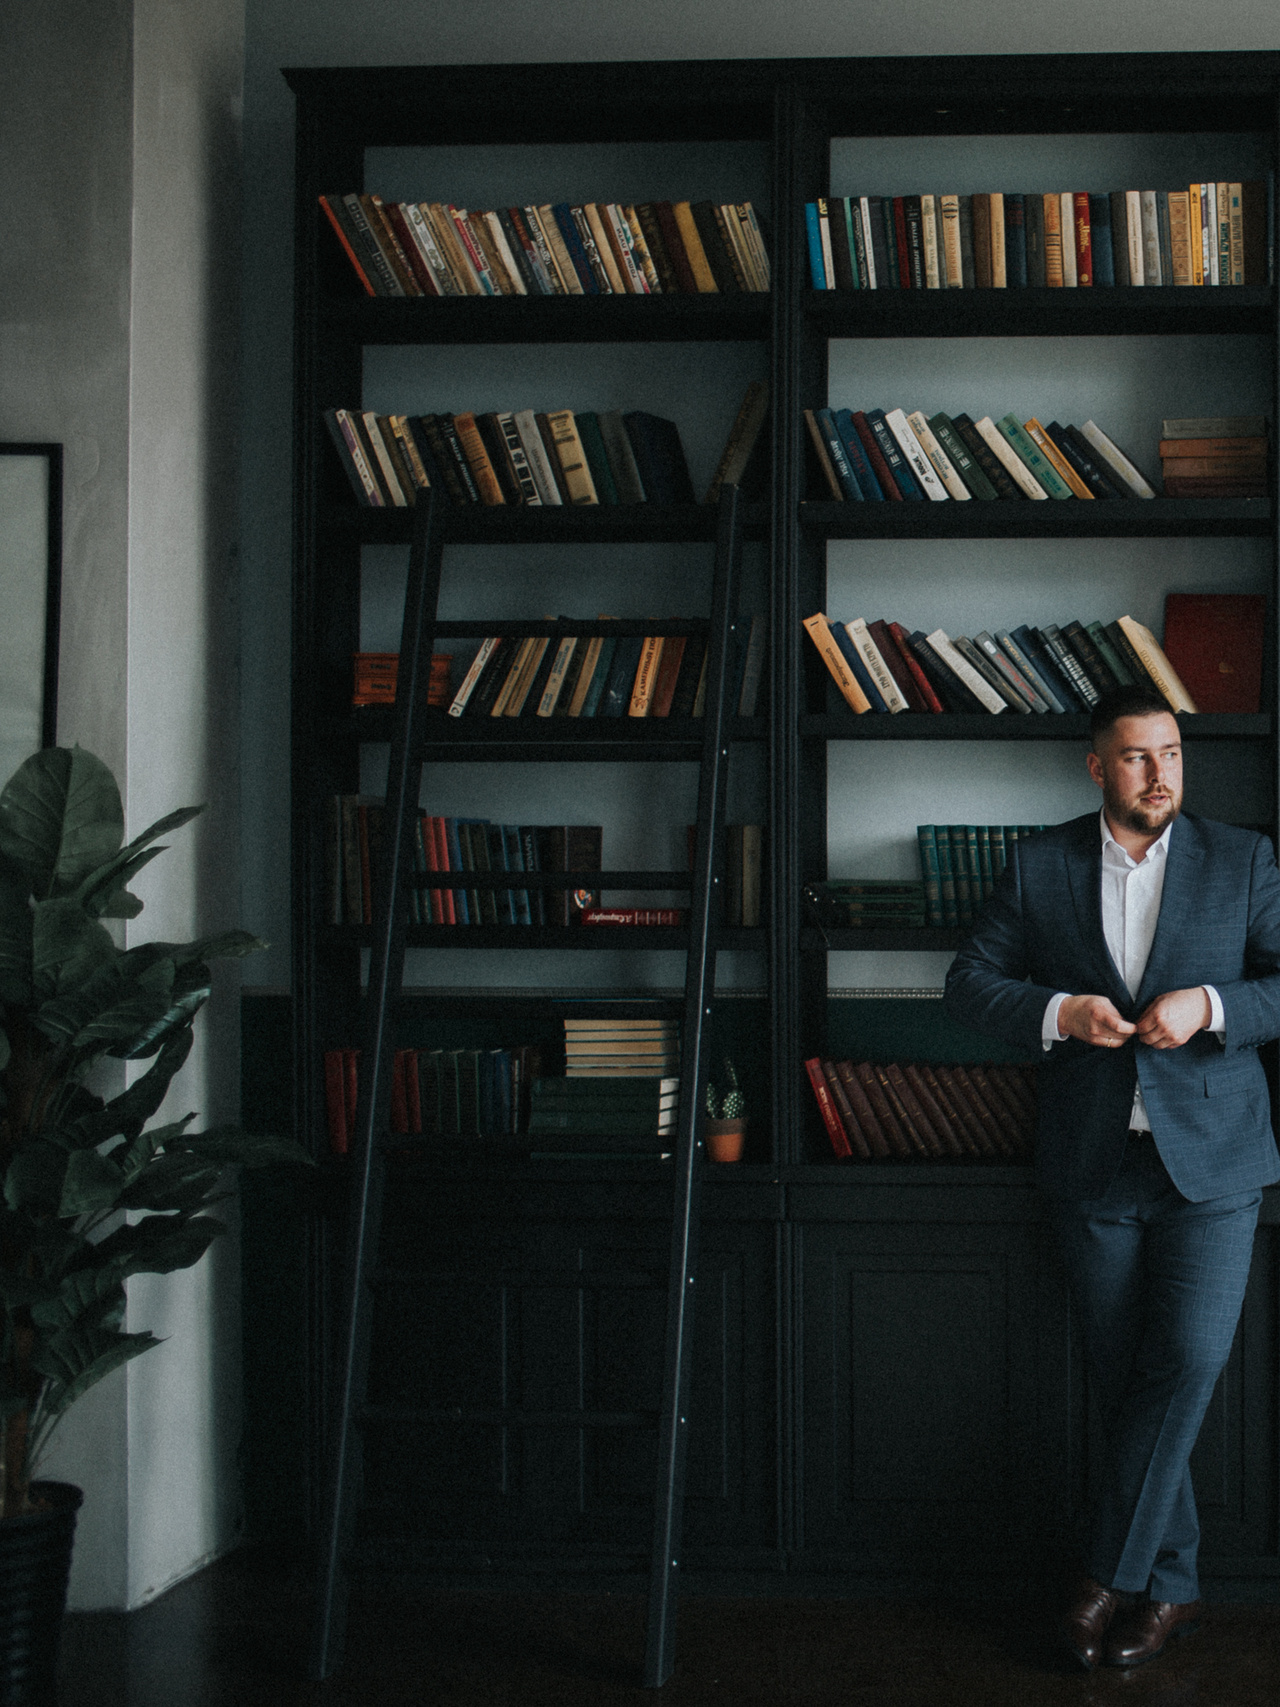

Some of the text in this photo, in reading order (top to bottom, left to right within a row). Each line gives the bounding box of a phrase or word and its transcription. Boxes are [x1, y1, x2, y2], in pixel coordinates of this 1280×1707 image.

[615, 227, 627, 249] ПУТИ
[625, 256, 636, 279] ГОДЫ
[636, 650, 655, 696] КАМЕННЫЙ
[1136, 648, 1171, 695] ШОЛОХОВ
